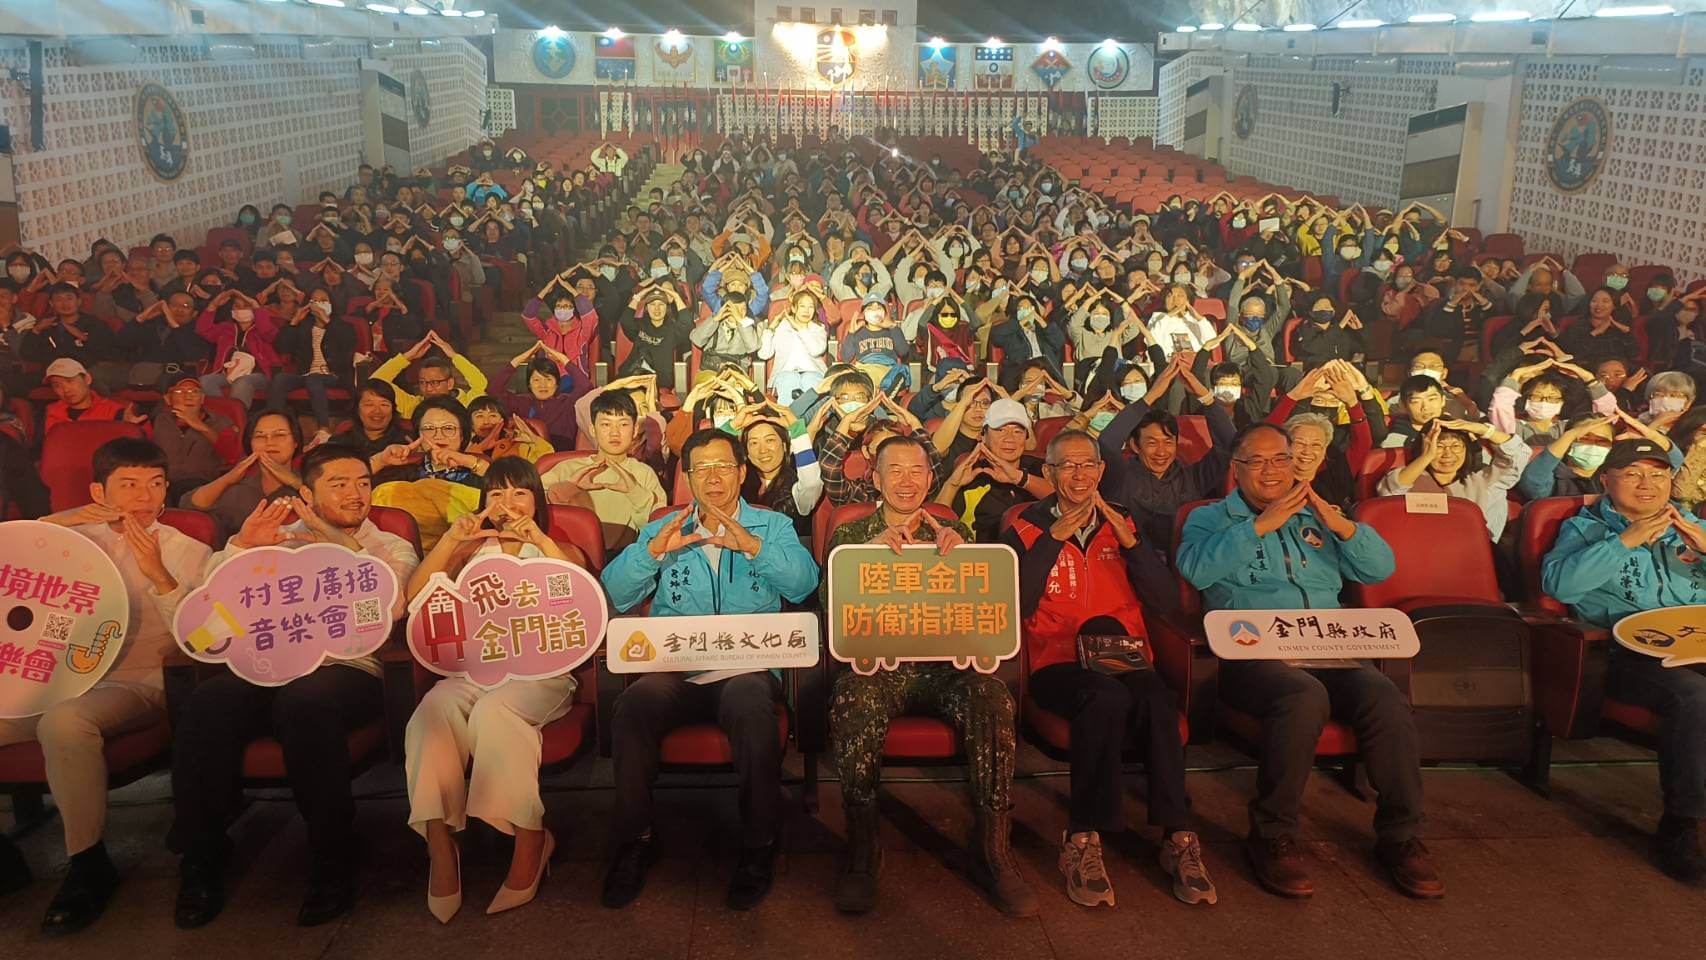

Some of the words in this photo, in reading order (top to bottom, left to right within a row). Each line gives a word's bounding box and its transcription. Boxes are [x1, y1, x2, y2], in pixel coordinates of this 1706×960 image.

[239, 562, 378, 609] 村里廣播
[468, 572, 541, 616] 飛去
[859, 561, 990, 595] 陸軍金門
[248, 604, 349, 651] 音樂會
[475, 609, 587, 662] 金門話
[842, 602, 1008, 637] 防衛指揮部
[1267, 616, 1397, 640] 金門縣政府
[663, 629, 807, 653] 金門縣文化局
